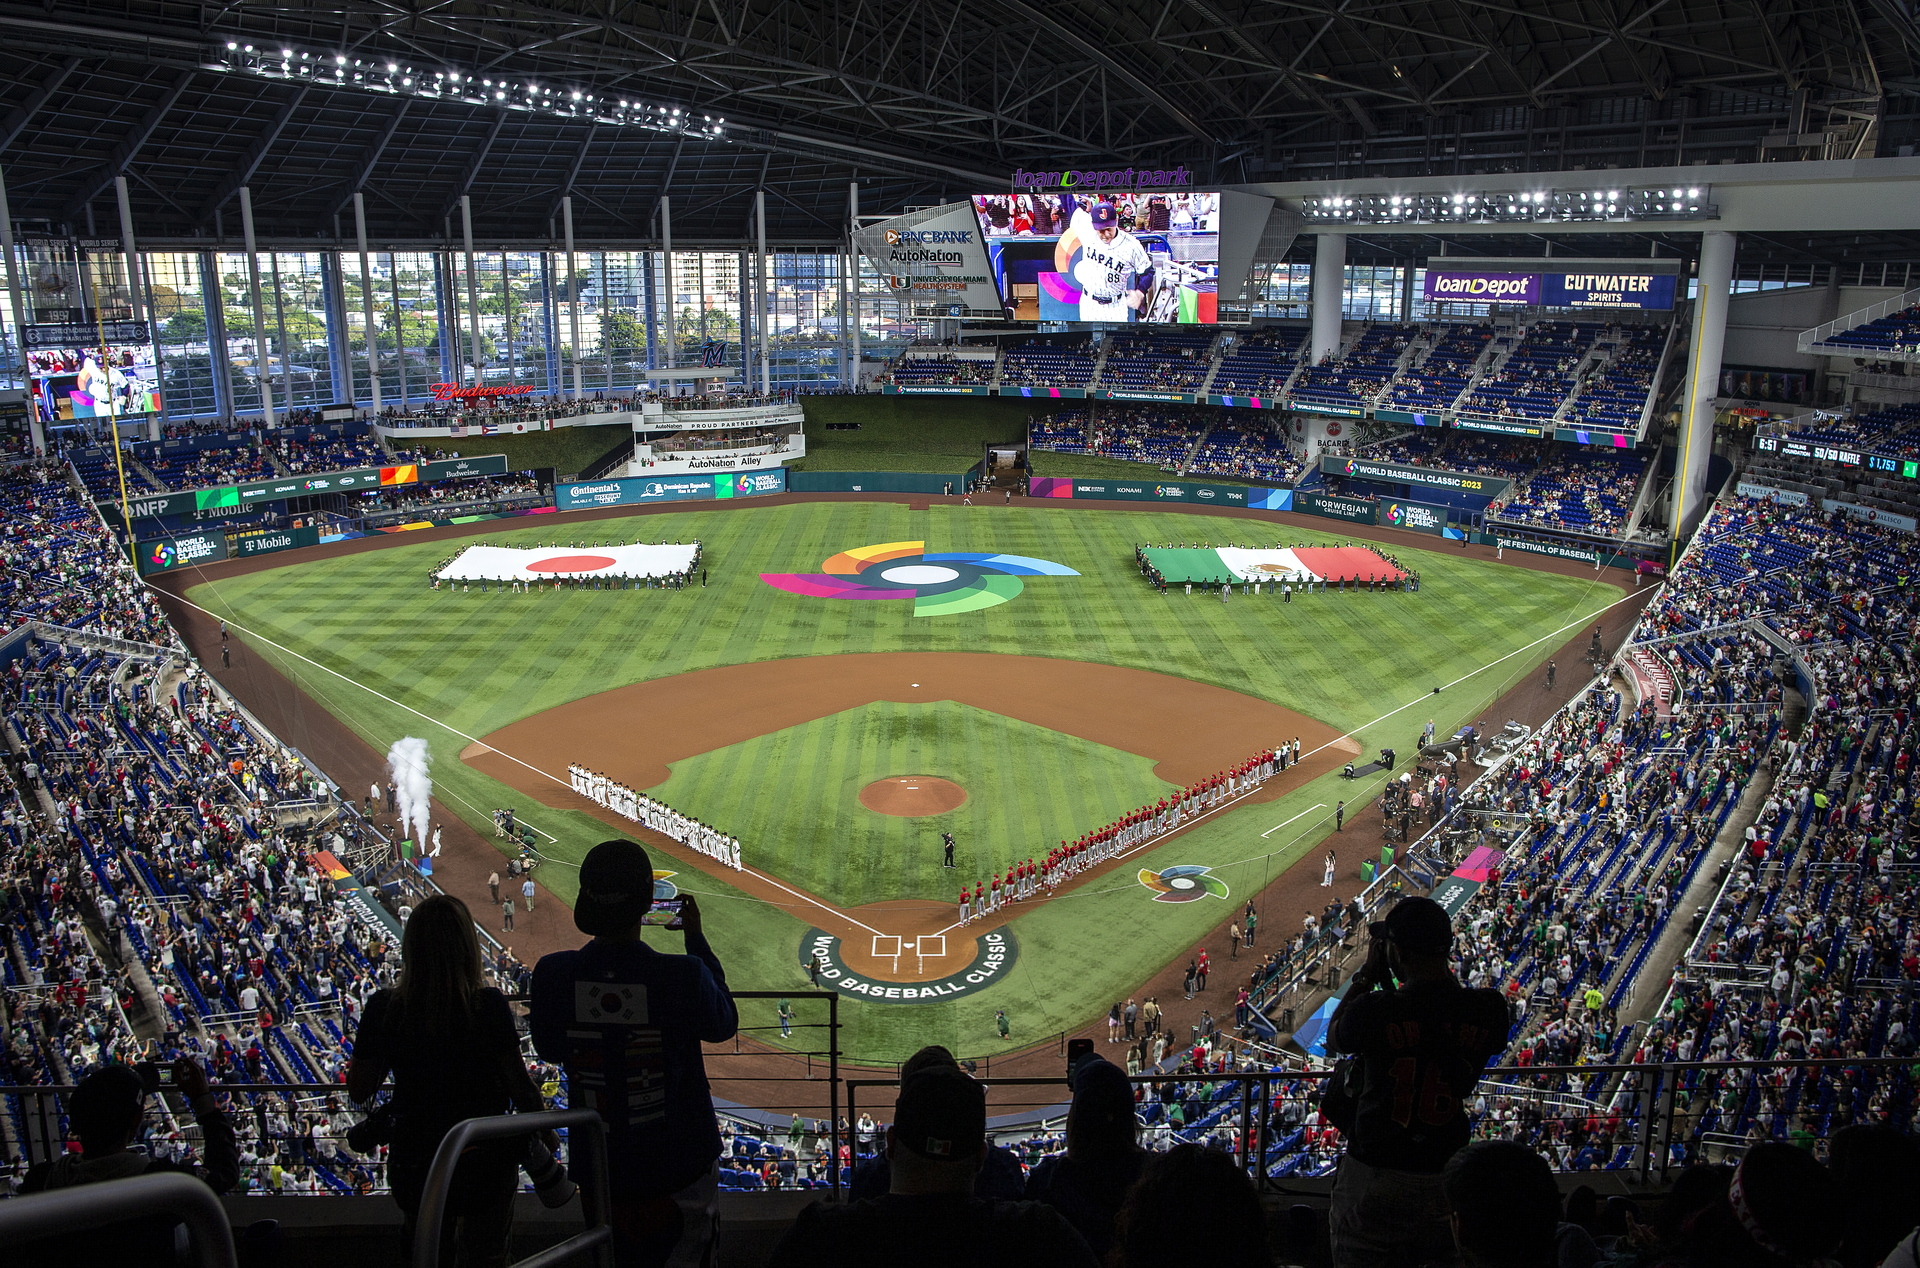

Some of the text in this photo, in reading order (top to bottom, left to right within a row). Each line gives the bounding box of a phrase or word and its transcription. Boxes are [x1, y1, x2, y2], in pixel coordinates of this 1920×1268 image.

[1015, 166, 1189, 190] loanDepot park
[26, 239, 69, 247] WORLD SERIES
[101, 239, 119, 247] SERIES
[890, 249, 961, 262] AutoNation
[1087, 247, 1126, 273] JAPAN
[1434, 275, 1529, 297] loanDepot
[1564, 274, 1650, 292] CUTWATER
[1587, 293, 1623, 302] SPIRITS
[949, 307, 959, 315] 42
[429, 381, 535, 401] Budweiser
[721, 420, 758, 428] PARTNERS
[1462, 421, 1479, 429] WORLD
[1480, 423, 1504, 431] BASEBALL
[1759, 438, 1777, 452] 6:51
[1814, 447, 1838, 461] 50/50
[1838, 452, 1861, 465] RAFFLE
[688, 457, 761, 468] AutoNation Alley
[446, 468, 480, 477] Budweiser
[1359, 465, 1482, 490] WORLD BASEBALL CLASSIC 2023
[570, 483, 614, 497] Continental
[1740, 485, 1805, 503] ESTRELLA JALISCO
[137, 499, 168, 517] NFP
[1315, 499, 1368, 514] NORWEGIAN
[1324, 507, 1342, 515] CRUISE
[1406, 506, 1431, 515] WORLD
[1406, 512, 1439, 523] BASEBALL
[1877, 514, 1902, 525] JALISCO
[175, 537, 205, 548] WORLD
[176, 541, 217, 554] BASEBALL
[257, 535, 292, 550] Mobile
[1496, 537, 1511, 546] THE
[1512, 541, 1547, 554] FESTIVAL
[1559, 549, 1596, 561] BASEBAL
[347, 896, 378, 923] WORLD
[811, 936, 841, 979] WORLD
[838, 977, 965, 999] BASEBALL
[966, 932, 1007, 984] CLASSIC
[1387, 1056, 1459, 1128] 16
